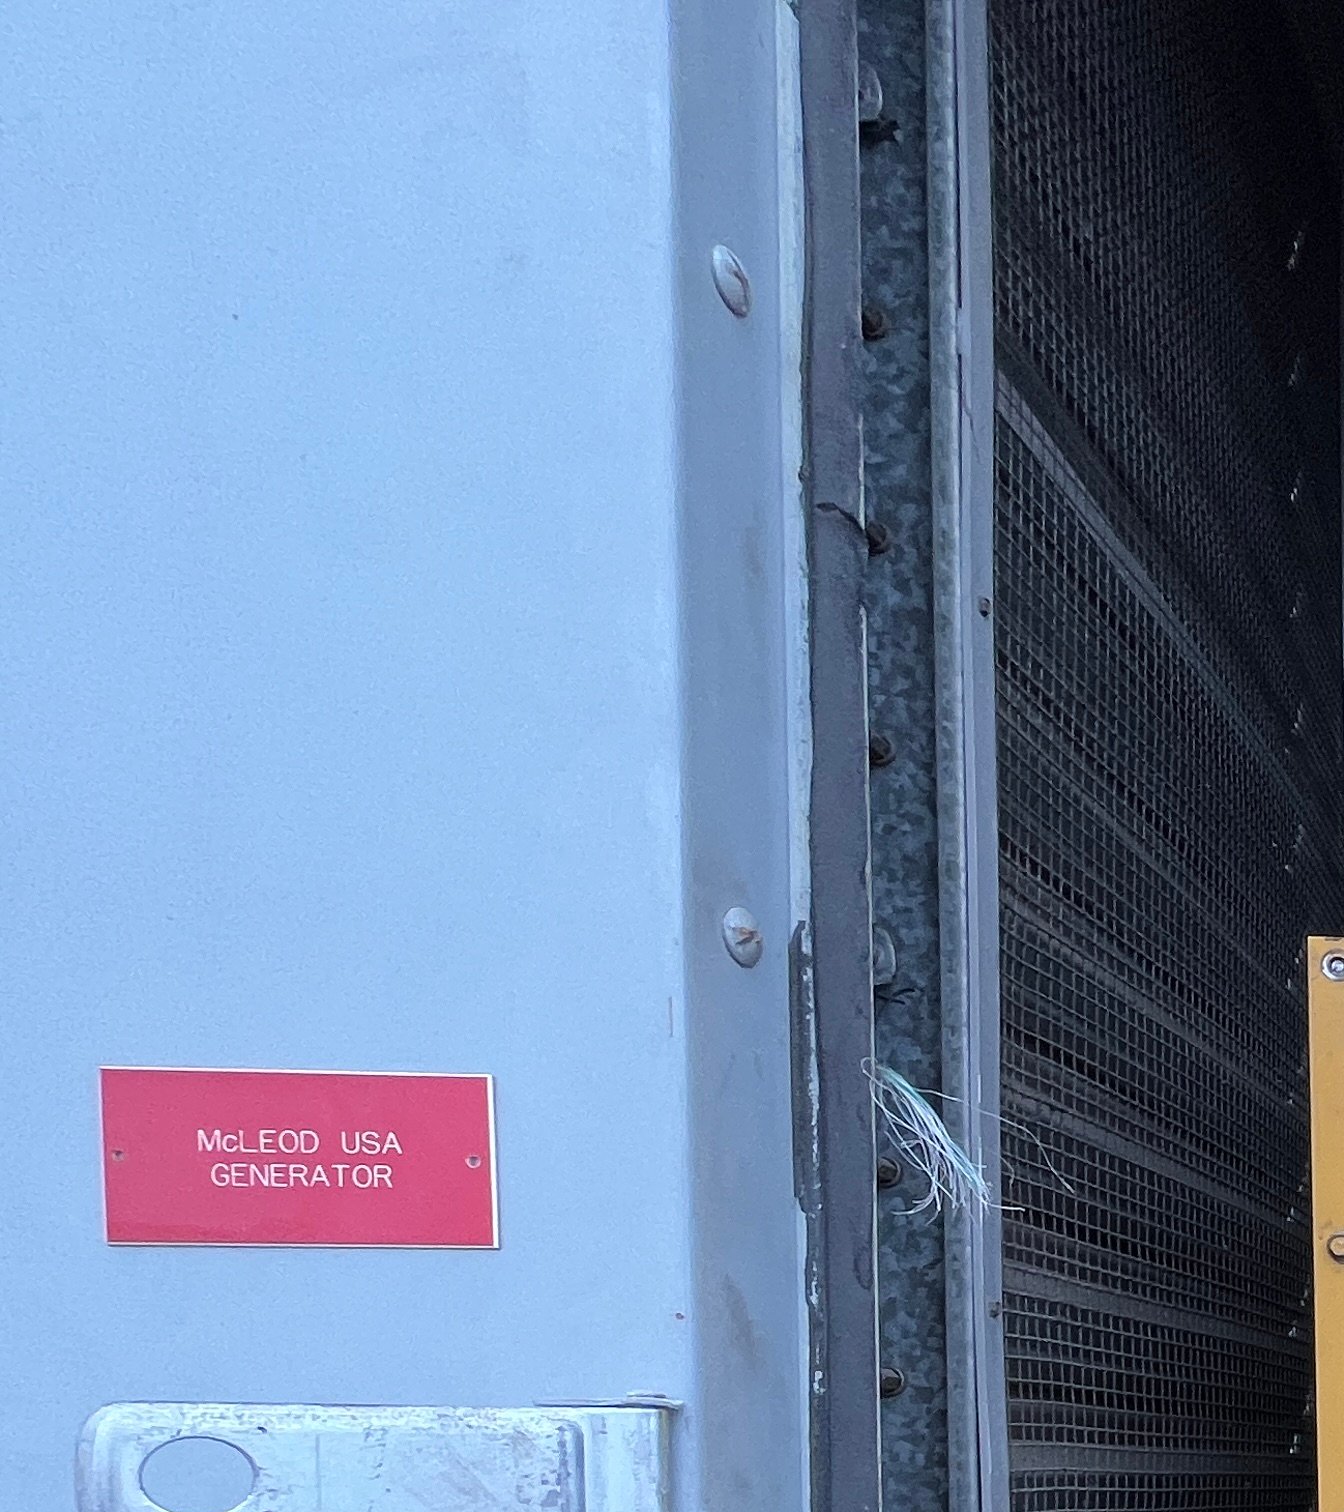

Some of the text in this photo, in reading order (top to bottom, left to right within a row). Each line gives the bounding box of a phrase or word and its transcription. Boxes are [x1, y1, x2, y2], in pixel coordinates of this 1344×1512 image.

[197, 1129, 403, 1155] McLEOD USA
[210, 1162, 393, 1188] GENERATOR
